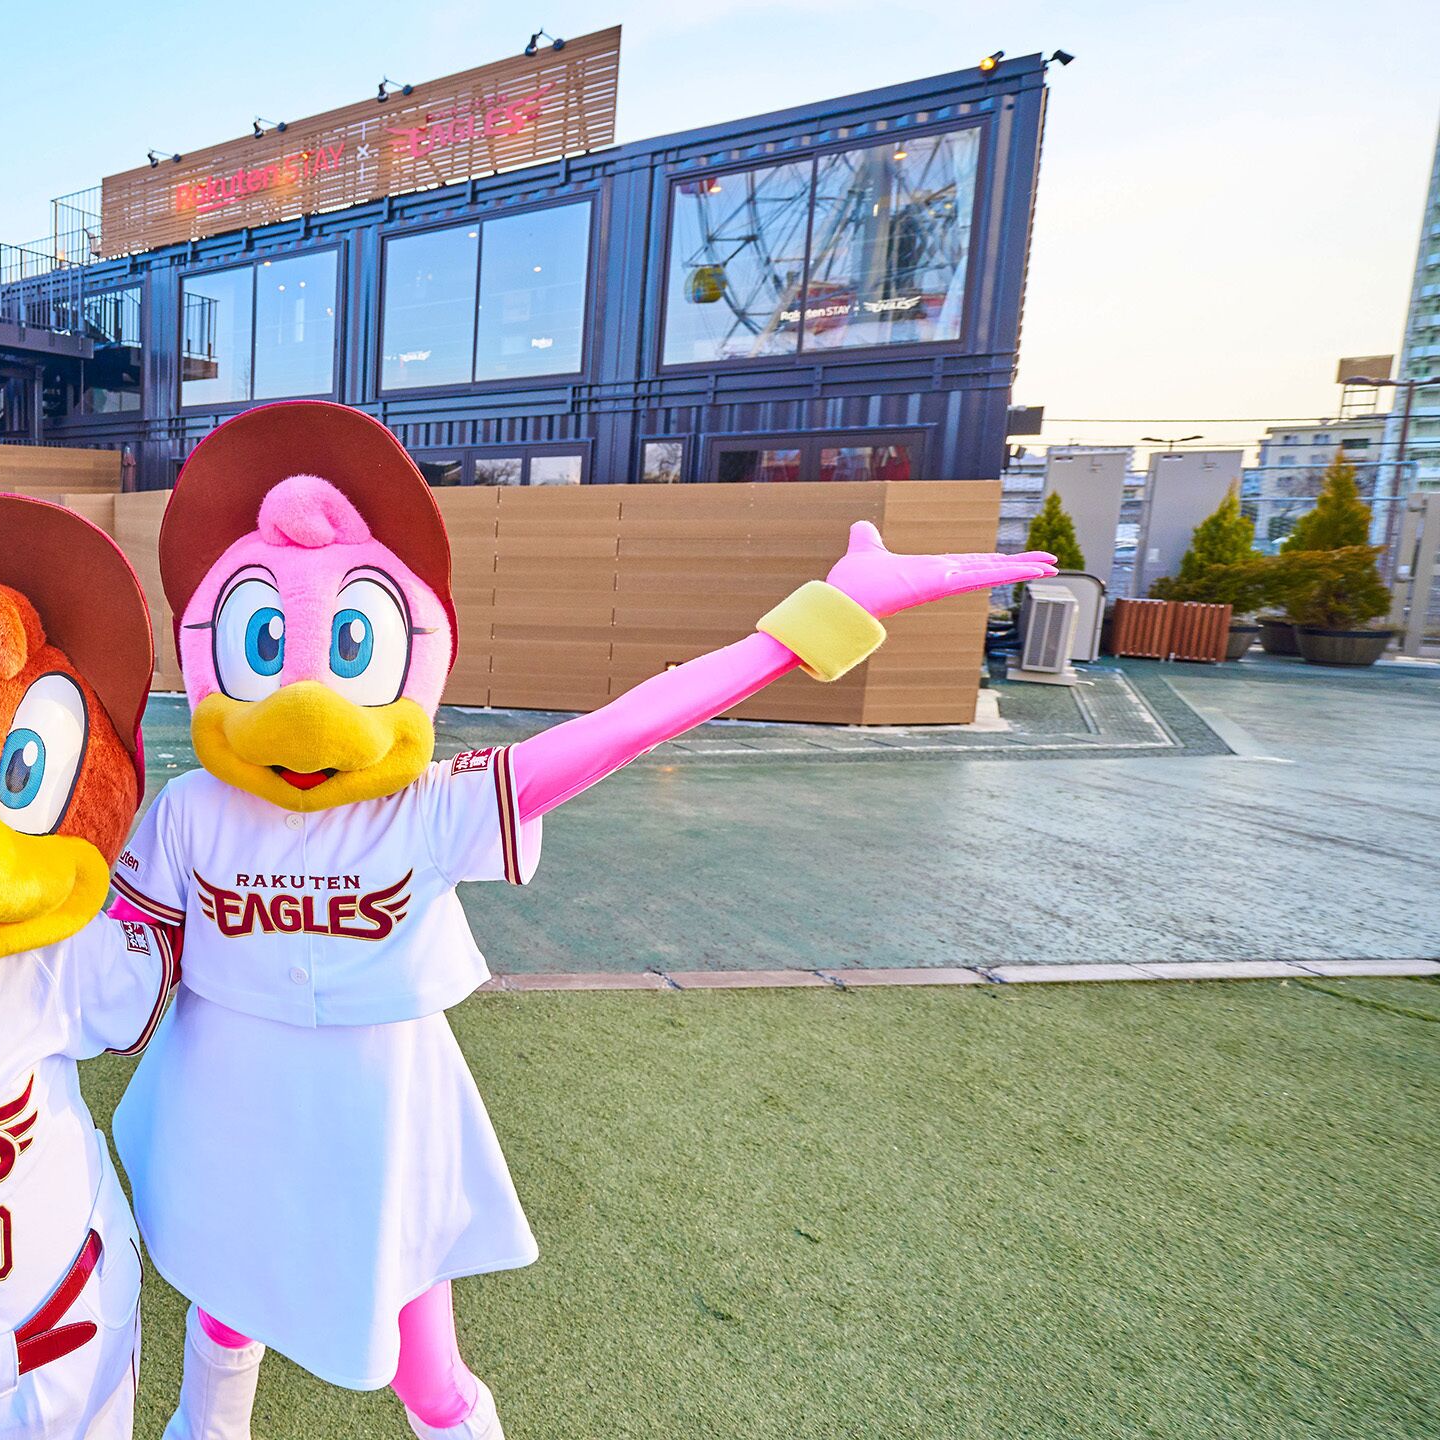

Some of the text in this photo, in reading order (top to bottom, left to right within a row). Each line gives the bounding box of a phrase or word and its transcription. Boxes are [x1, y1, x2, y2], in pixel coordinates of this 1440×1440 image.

[176, 163, 280, 212] Rakuten
[284, 143, 345, 184] STAY
[385, 82, 556, 157] EAGLES
[780, 307, 826, 321] Rakten
[825, 305, 851, 317] STAY
[236, 873, 360, 890] RAKUTEN
[193, 868, 413, 941] EAGLES
